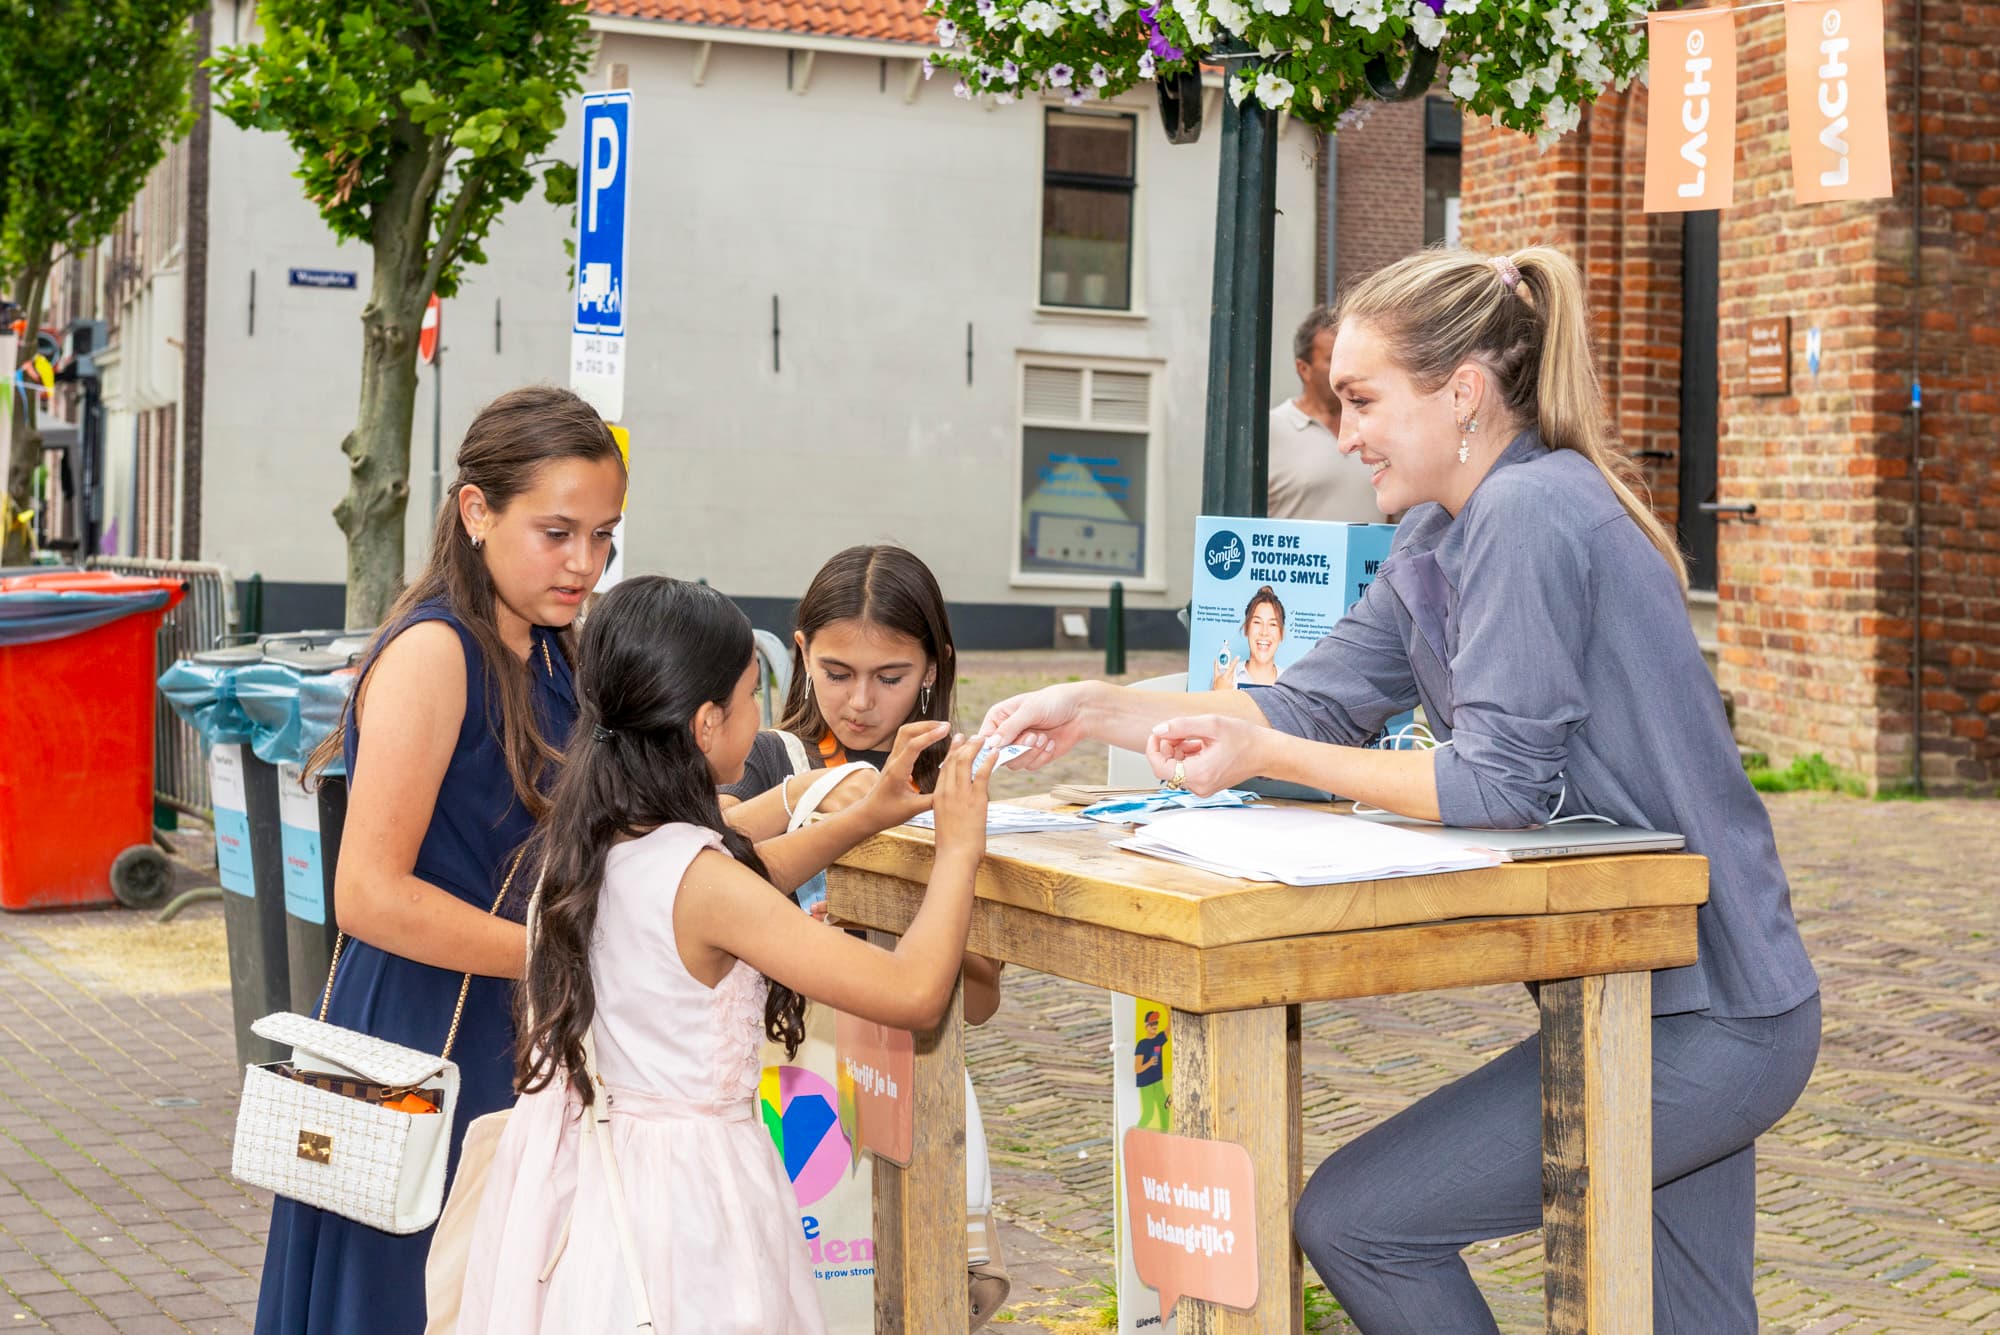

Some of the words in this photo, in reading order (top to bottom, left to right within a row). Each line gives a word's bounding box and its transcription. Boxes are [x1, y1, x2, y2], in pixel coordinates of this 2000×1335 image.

[588, 117, 620, 233] P
[1207, 537, 1241, 571] Smyle
[1252, 533, 1274, 548] BYE
[1277, 536, 1300, 549] BYE
[1251, 551, 1331, 570] TOOTHPASTE,
[1250, 568, 1286, 582] HELLO
[1290, 571, 1329, 585] SMYLE
[887, 1073, 897, 1099] in
[1142, 1176, 1171, 1205] Wat
[1173, 1182, 1210, 1212] vind
[1146, 1213, 1235, 1257] belangrijk?
[825, 1270, 848, 1280] grow
[850, 1267, 875, 1277] stron
